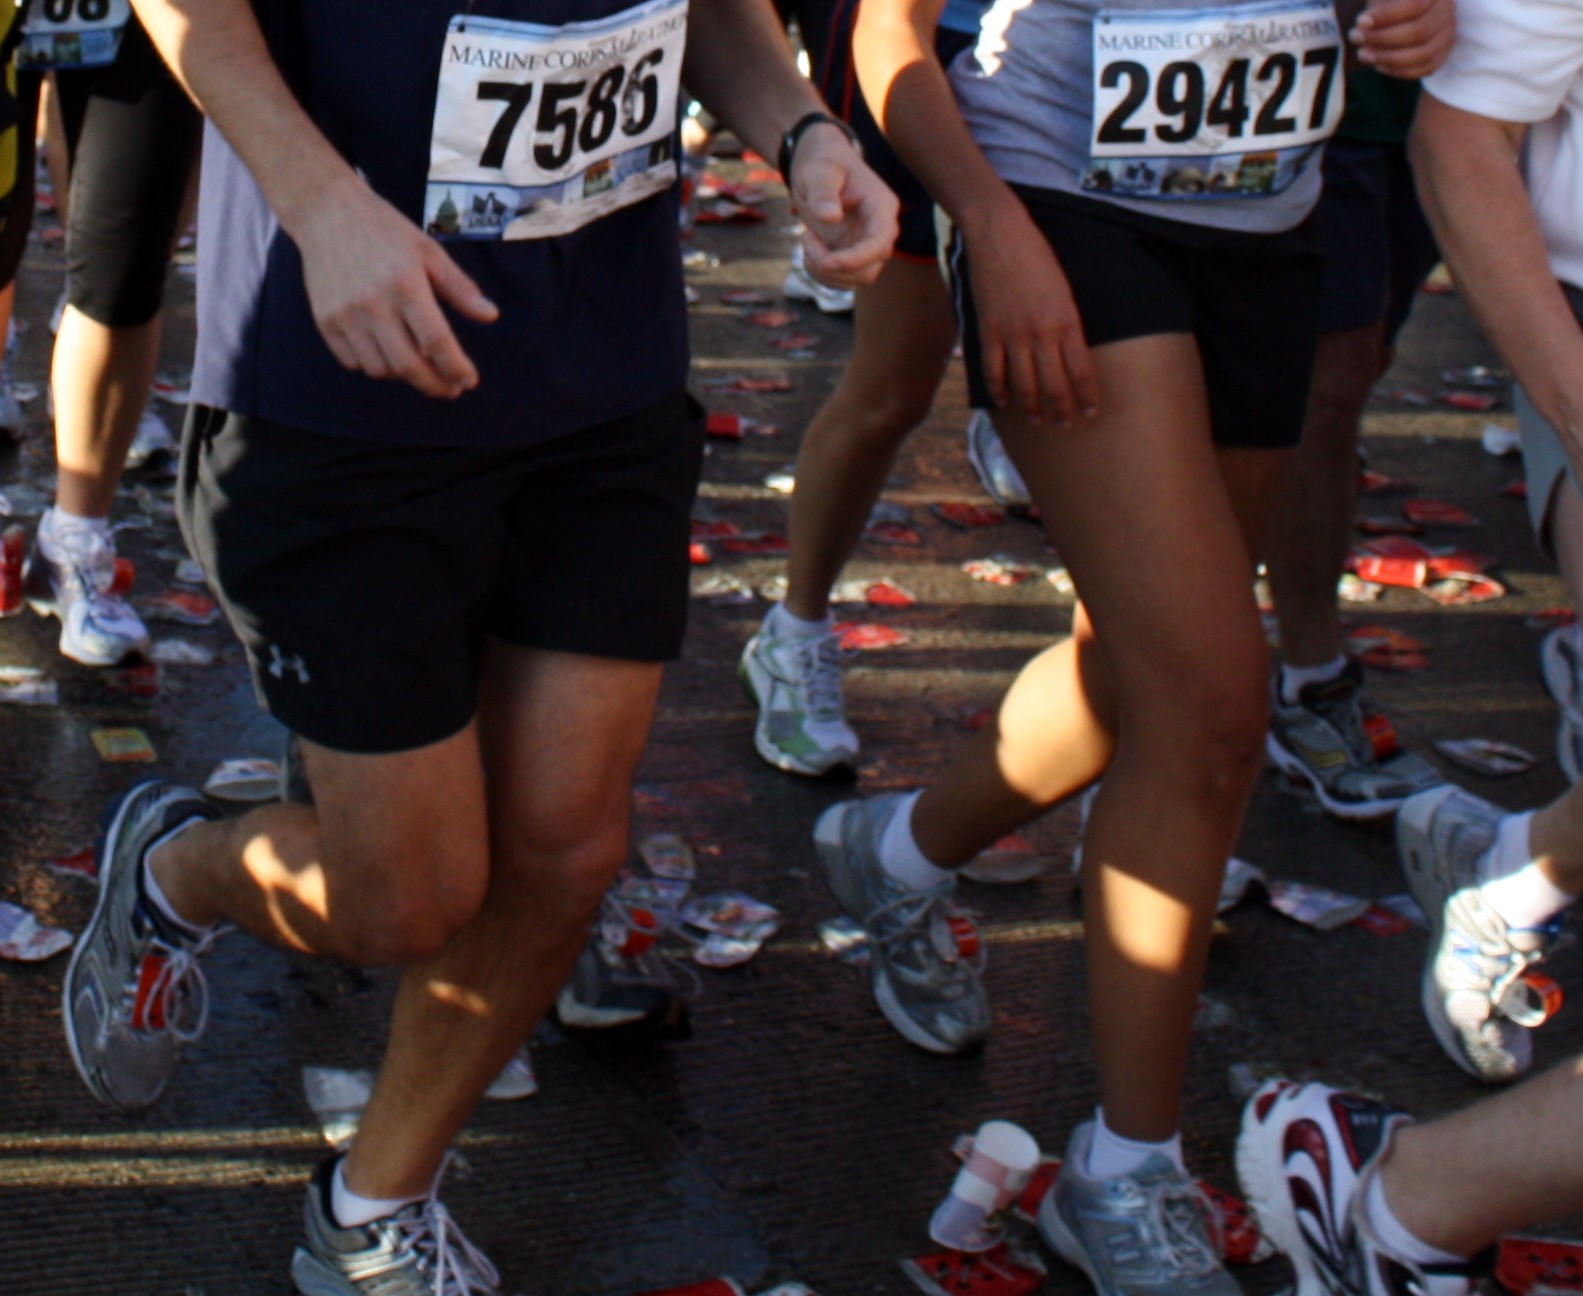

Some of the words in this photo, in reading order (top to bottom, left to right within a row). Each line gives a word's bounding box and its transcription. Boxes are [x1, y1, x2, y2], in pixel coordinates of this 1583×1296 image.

[448, 44, 537, 71] MARINE
[1097, 32, 1185, 51] MARINE
[476, 48, 664, 172] 7586
[1096, 45, 1341, 144] 29427
